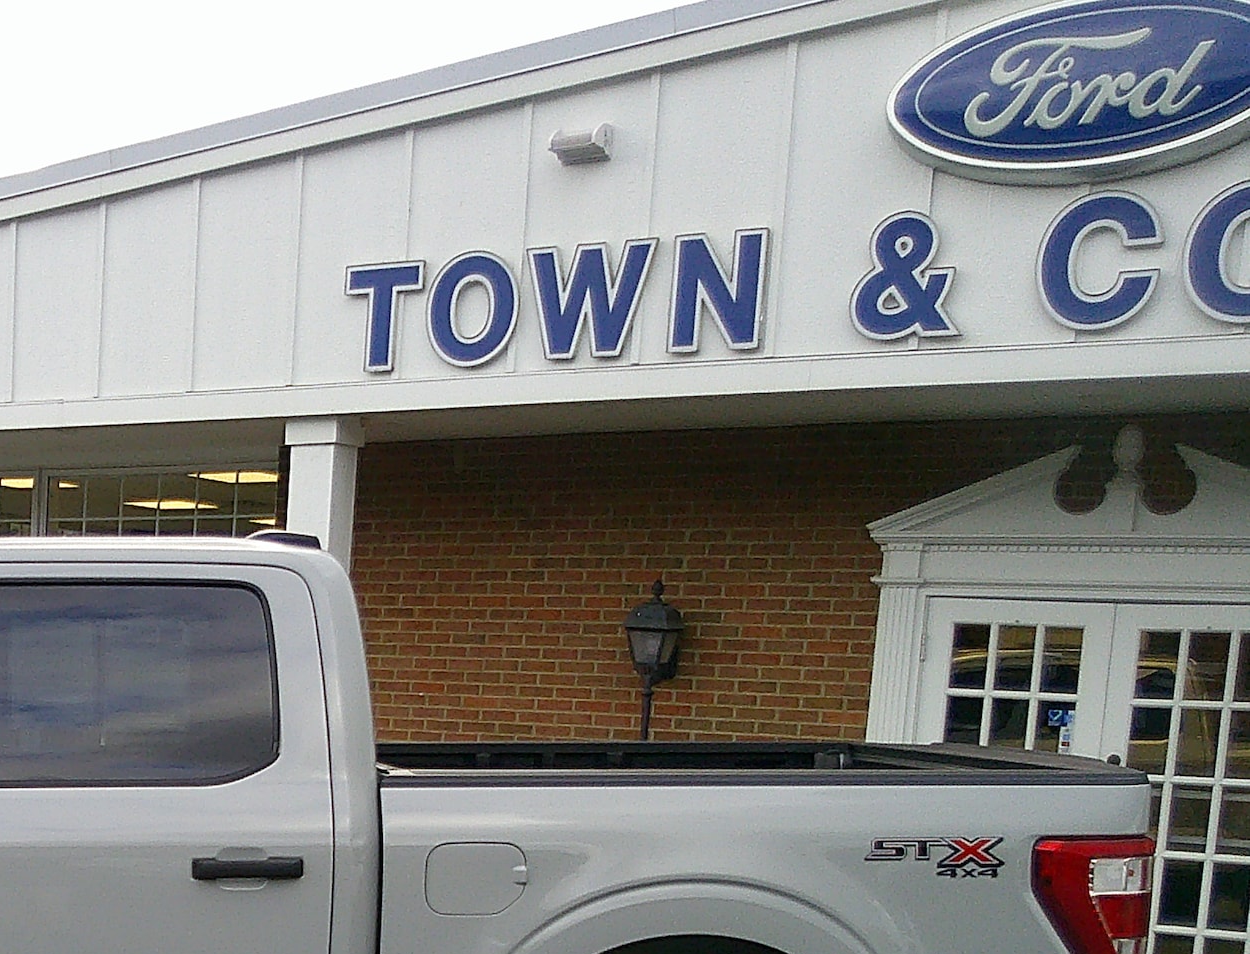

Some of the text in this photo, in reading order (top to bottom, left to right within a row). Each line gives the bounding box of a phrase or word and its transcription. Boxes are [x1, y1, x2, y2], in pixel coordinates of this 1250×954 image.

[964, 27, 1217, 138] Ford
[345, 226, 770, 373] TOWN
[850, 210, 961, 341] &
[864, 836, 1005, 868] STX
